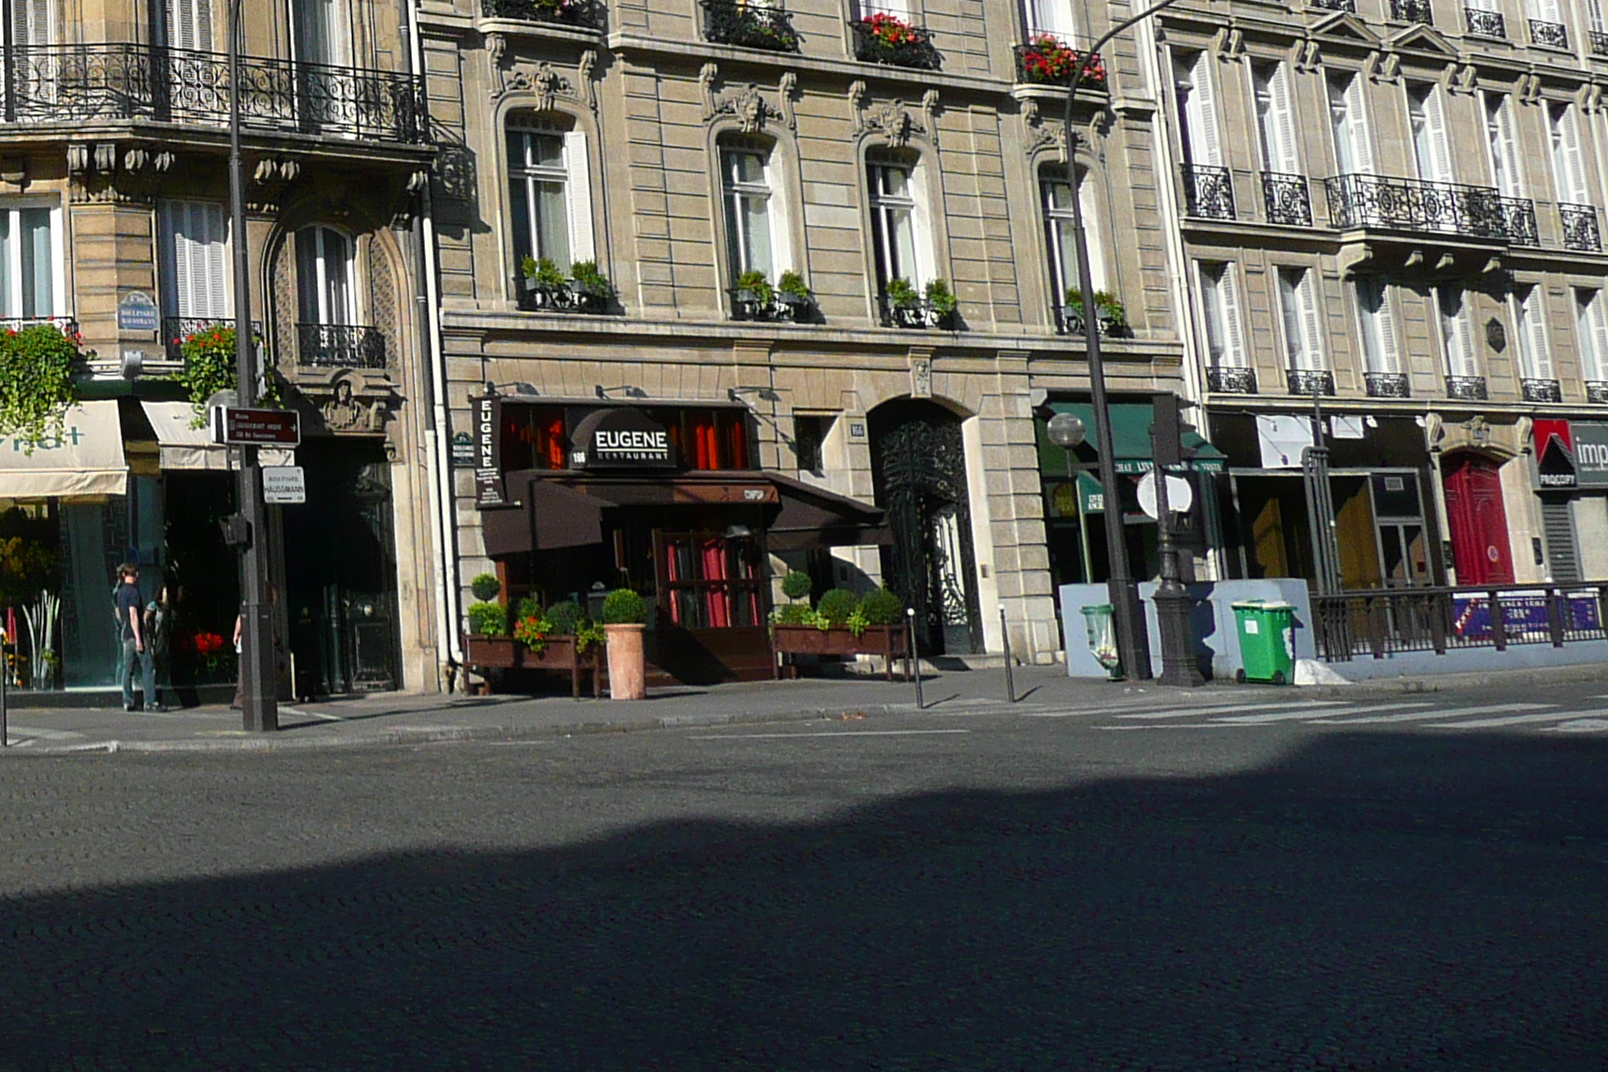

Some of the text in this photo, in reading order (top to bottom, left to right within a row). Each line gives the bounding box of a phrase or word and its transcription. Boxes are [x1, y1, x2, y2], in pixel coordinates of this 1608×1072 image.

[480, 400, 492, 467] EUGENE
[595, 431, 668, 448] EUGENE
[597, 452, 668, 460] RESTAURANT
